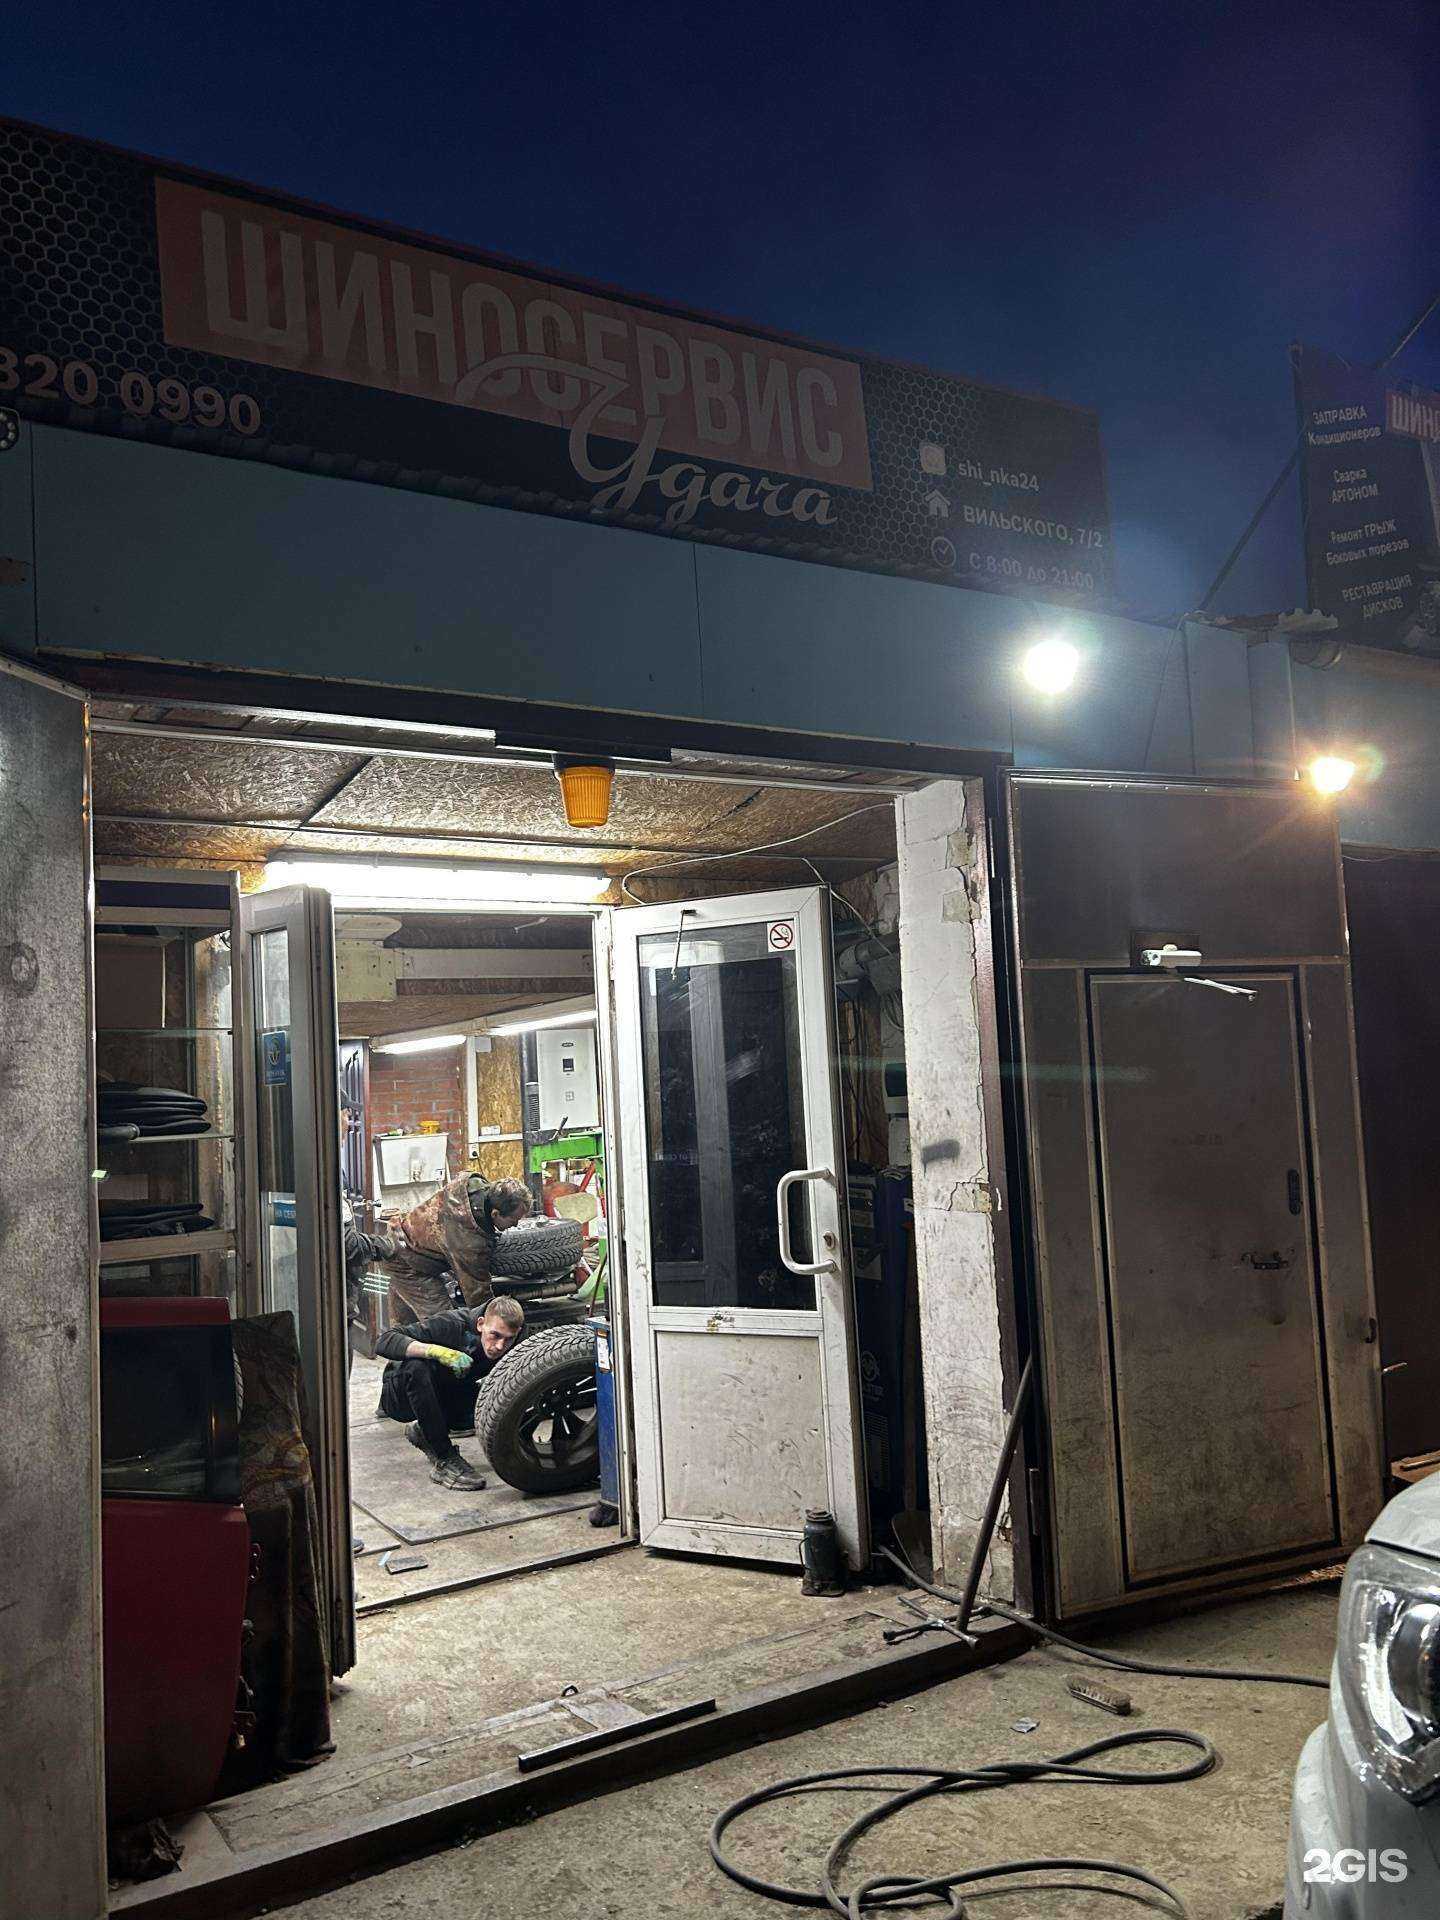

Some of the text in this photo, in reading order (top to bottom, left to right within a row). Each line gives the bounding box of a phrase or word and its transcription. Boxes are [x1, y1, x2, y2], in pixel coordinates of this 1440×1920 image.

[201, 209, 845, 470] ШИНОСЕРВИС
[120, 369, 262, 436] 0990
[1312, 405, 1368, 425] ЗАПРАВКА
[957, 459, 1040, 491] shi_nka24
[1331, 483, 1379, 504] АРГОНОМ
[963, 505, 1104, 549] ВИЛЬСКОГО, 7/2
[1364, 519, 1397, 538] ГРЫЖ
[968, 552, 981, 570] С
[1342, 574, 1413, 602] РЕСТАВРАЦИЯ
[1362, 596, 1404, 618] ДИСКОВ
